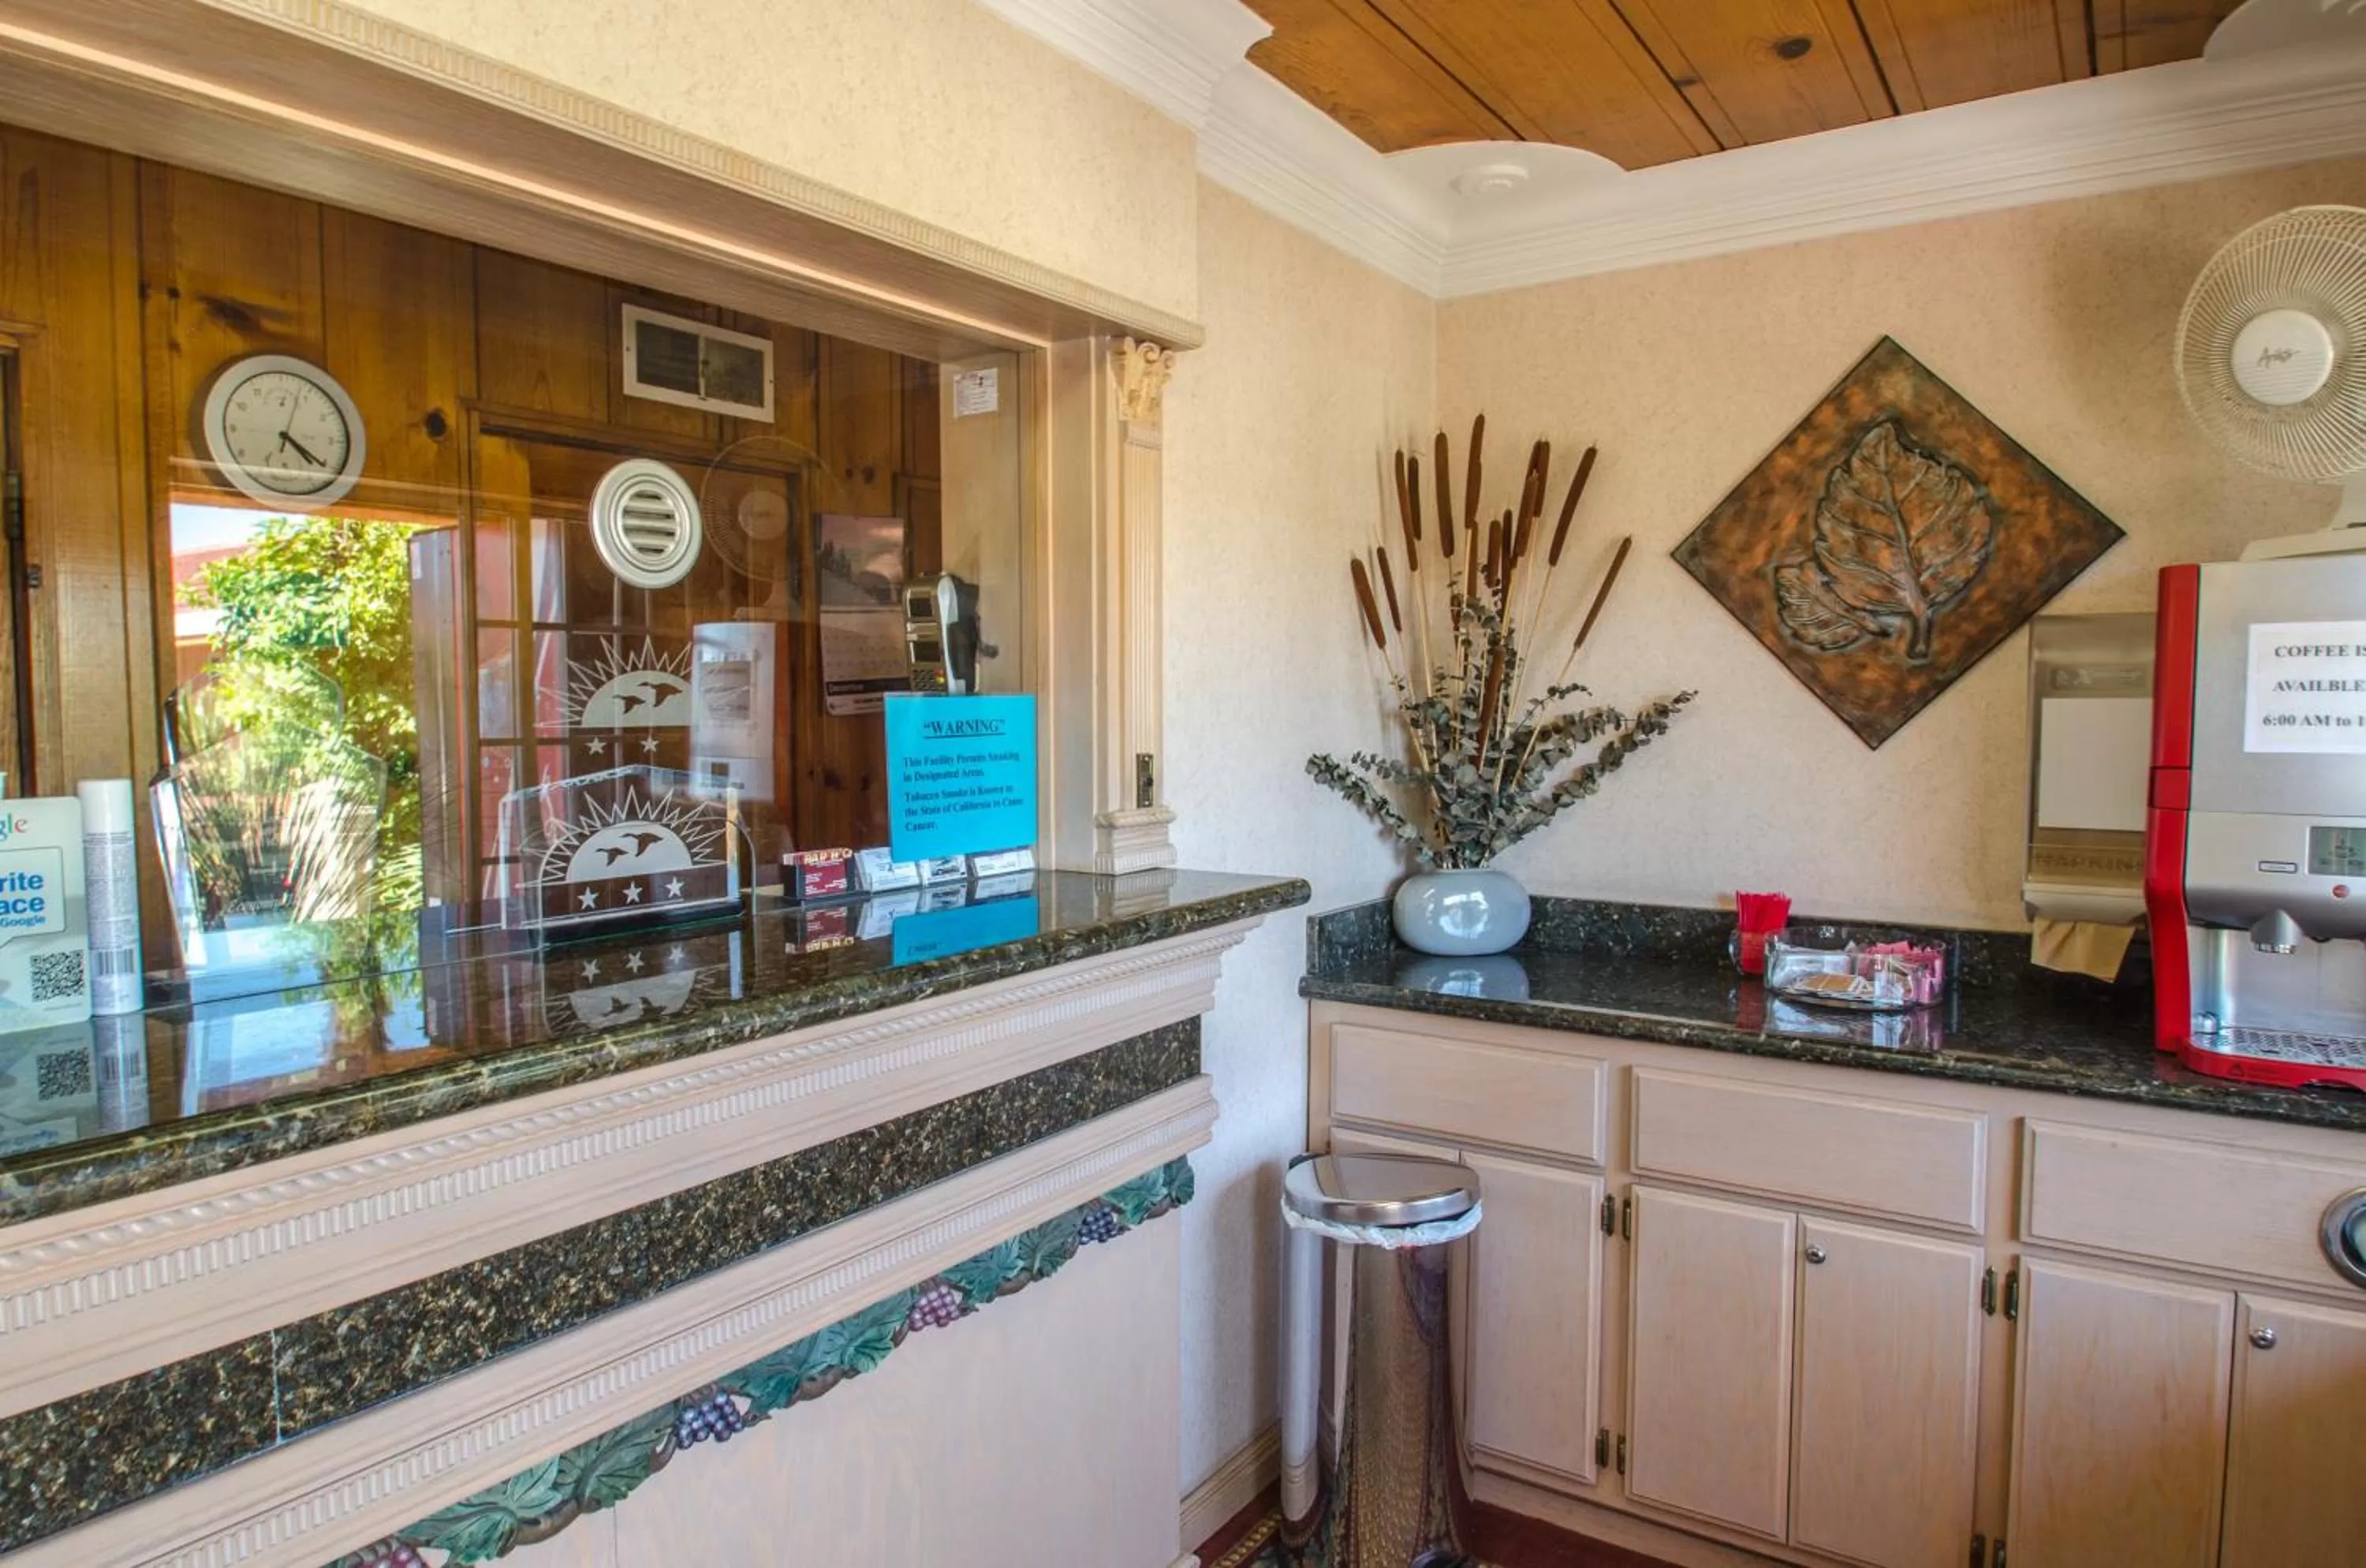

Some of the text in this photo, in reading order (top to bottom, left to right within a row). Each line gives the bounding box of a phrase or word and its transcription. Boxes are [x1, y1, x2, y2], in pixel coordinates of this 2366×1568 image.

[2275, 644, 2350, 657] COFFEE
[2271, 679, 2366, 692] AVAILBLE
[2263, 714, 2297, 726] 6:00
[2300, 714, 2331, 726] AM
[2336, 715, 2352, 726] to
[914, 769, 959, 782] Designated
[905, 791, 939, 802] Tobacco
[940, 787, 968, 799] Smoke
